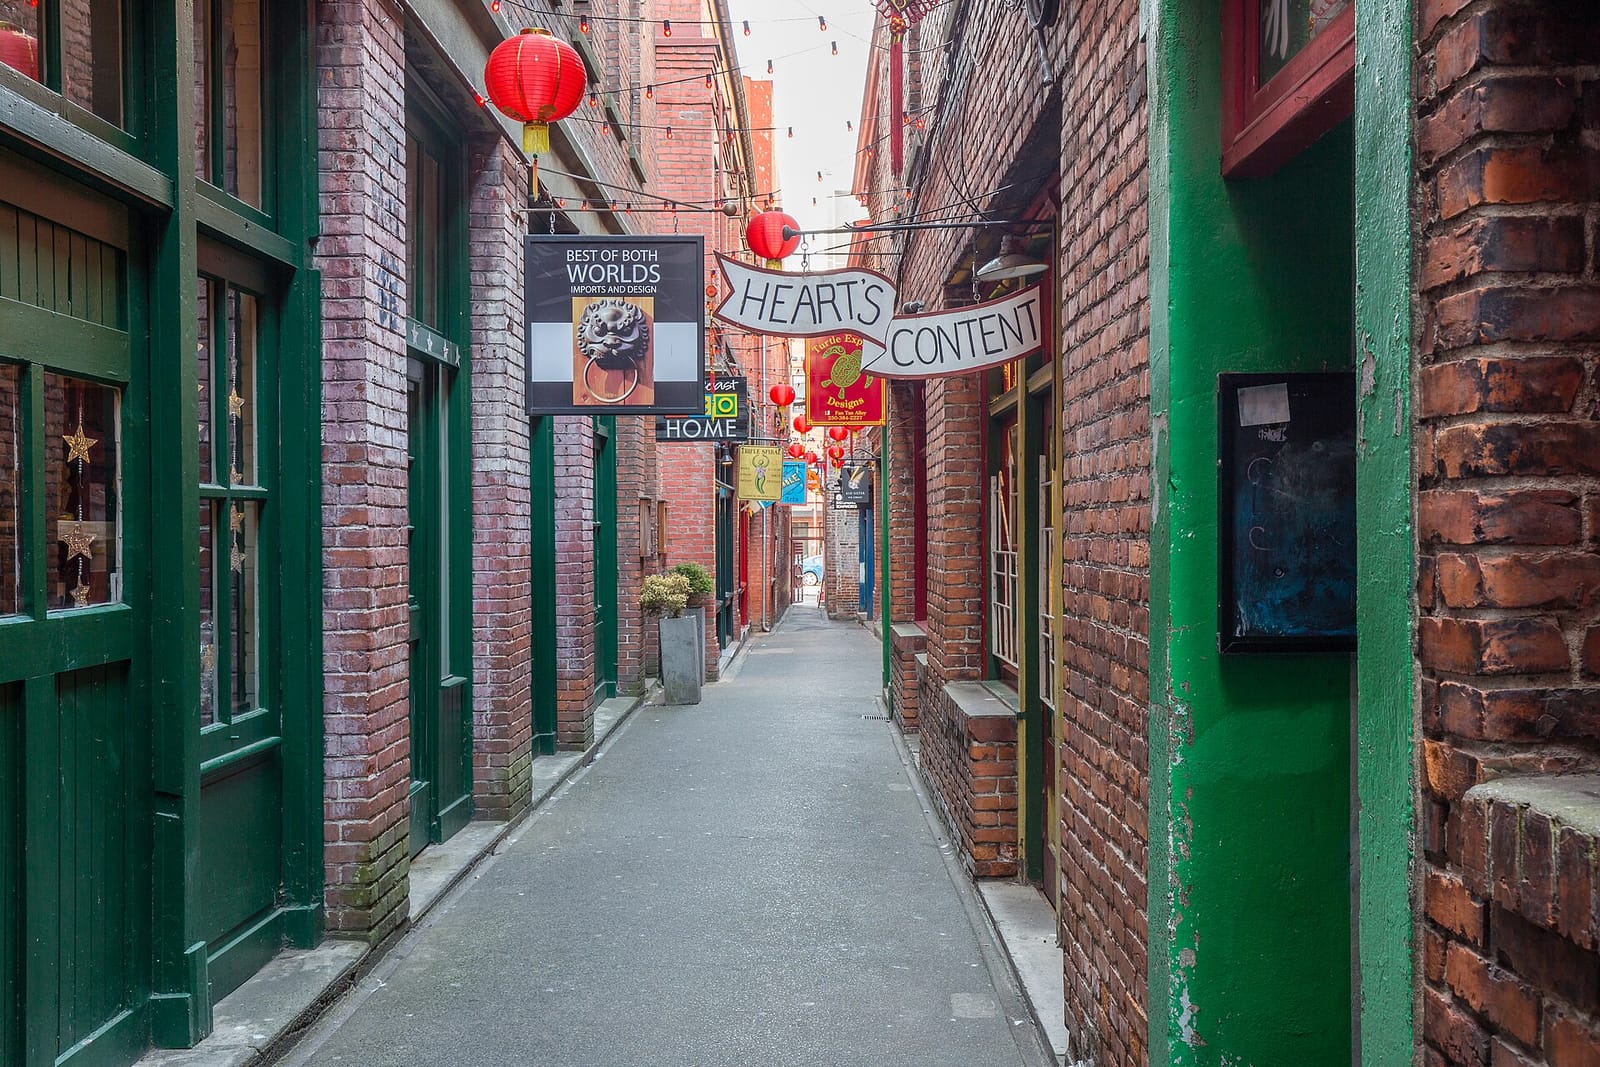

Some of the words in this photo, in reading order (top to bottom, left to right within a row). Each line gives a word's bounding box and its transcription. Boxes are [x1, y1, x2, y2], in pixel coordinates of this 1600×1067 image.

[566, 249, 598, 262] BEST
[600, 249, 619, 262] OF
[622, 249, 658, 262] BOTH
[566, 264, 661, 283] WORLDS
[570, 285, 606, 294] IMPORTS
[607, 285, 626, 294] AND
[627, 285, 657, 294] DESIGN
[739, 277, 884, 326] HEART'S
[890, 297, 1037, 367] CONTENT
[812, 335, 842, 354] Turtle
[844, 333, 863, 347] Exp
[826, 396, 865, 410] Designs
[666, 419, 737, 438] HOME
